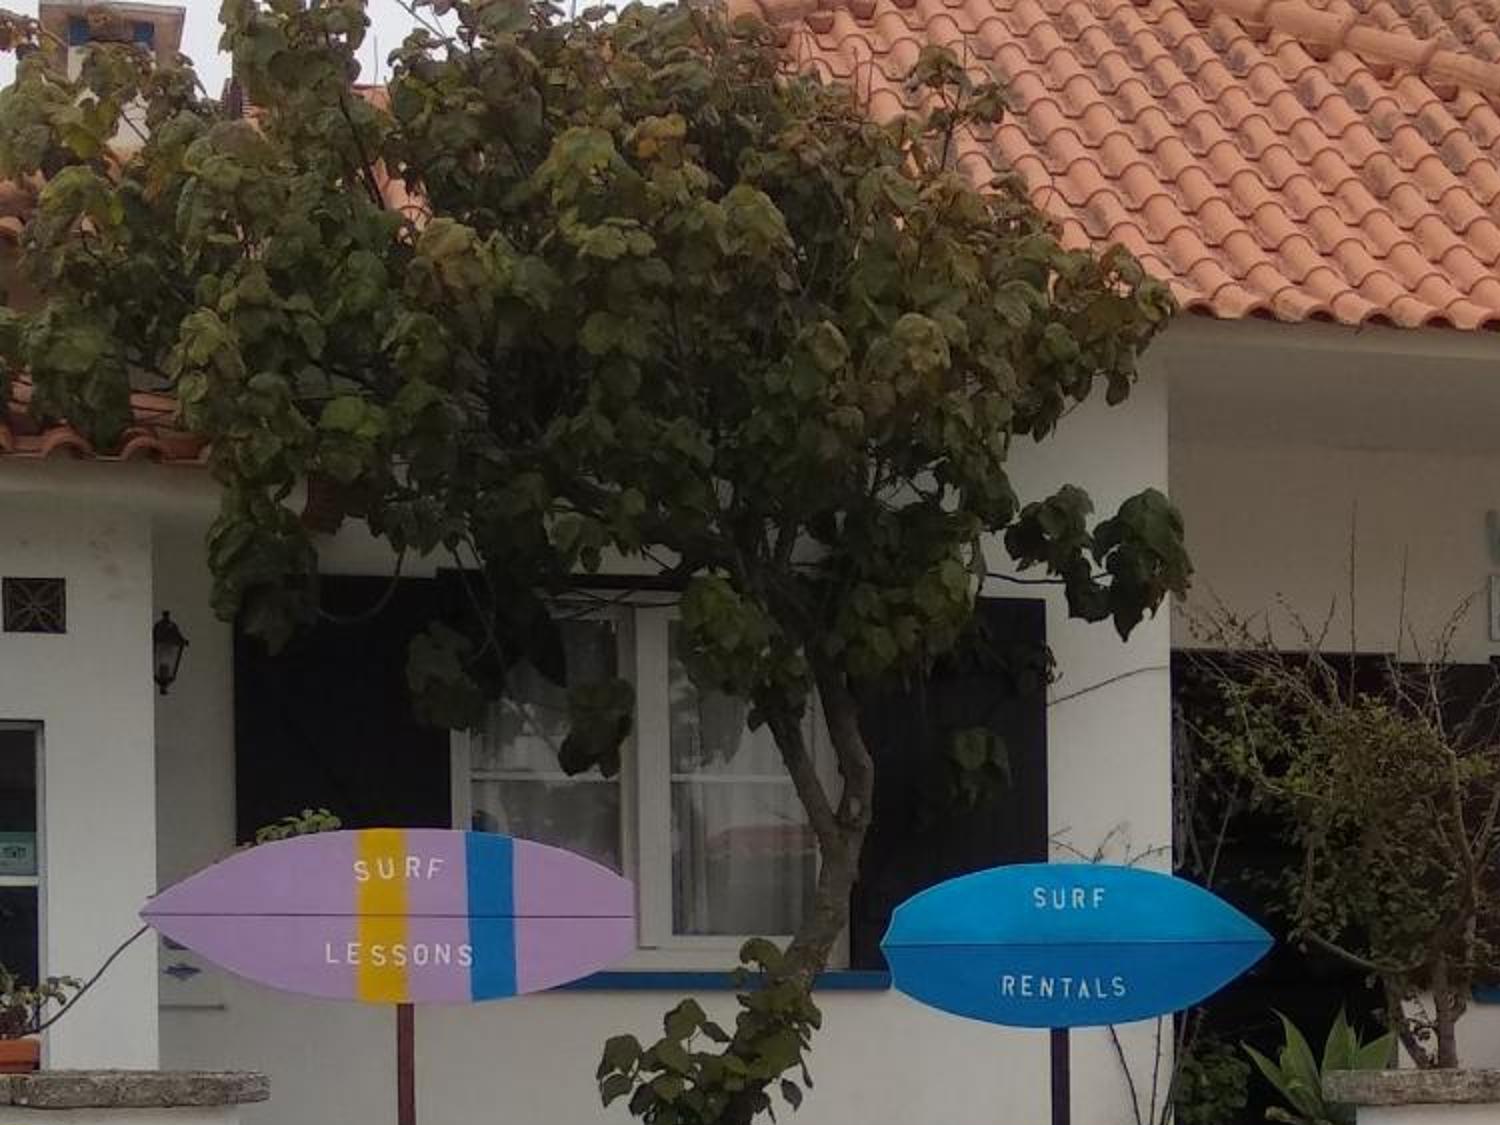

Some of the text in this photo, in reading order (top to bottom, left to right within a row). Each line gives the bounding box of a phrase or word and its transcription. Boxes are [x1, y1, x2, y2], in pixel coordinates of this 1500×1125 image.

[353, 857, 445, 882] SURF
[1033, 888, 1105, 910] SURF
[325, 943, 474, 967] LESSONS
[1001, 976, 1127, 999] RENTALS
